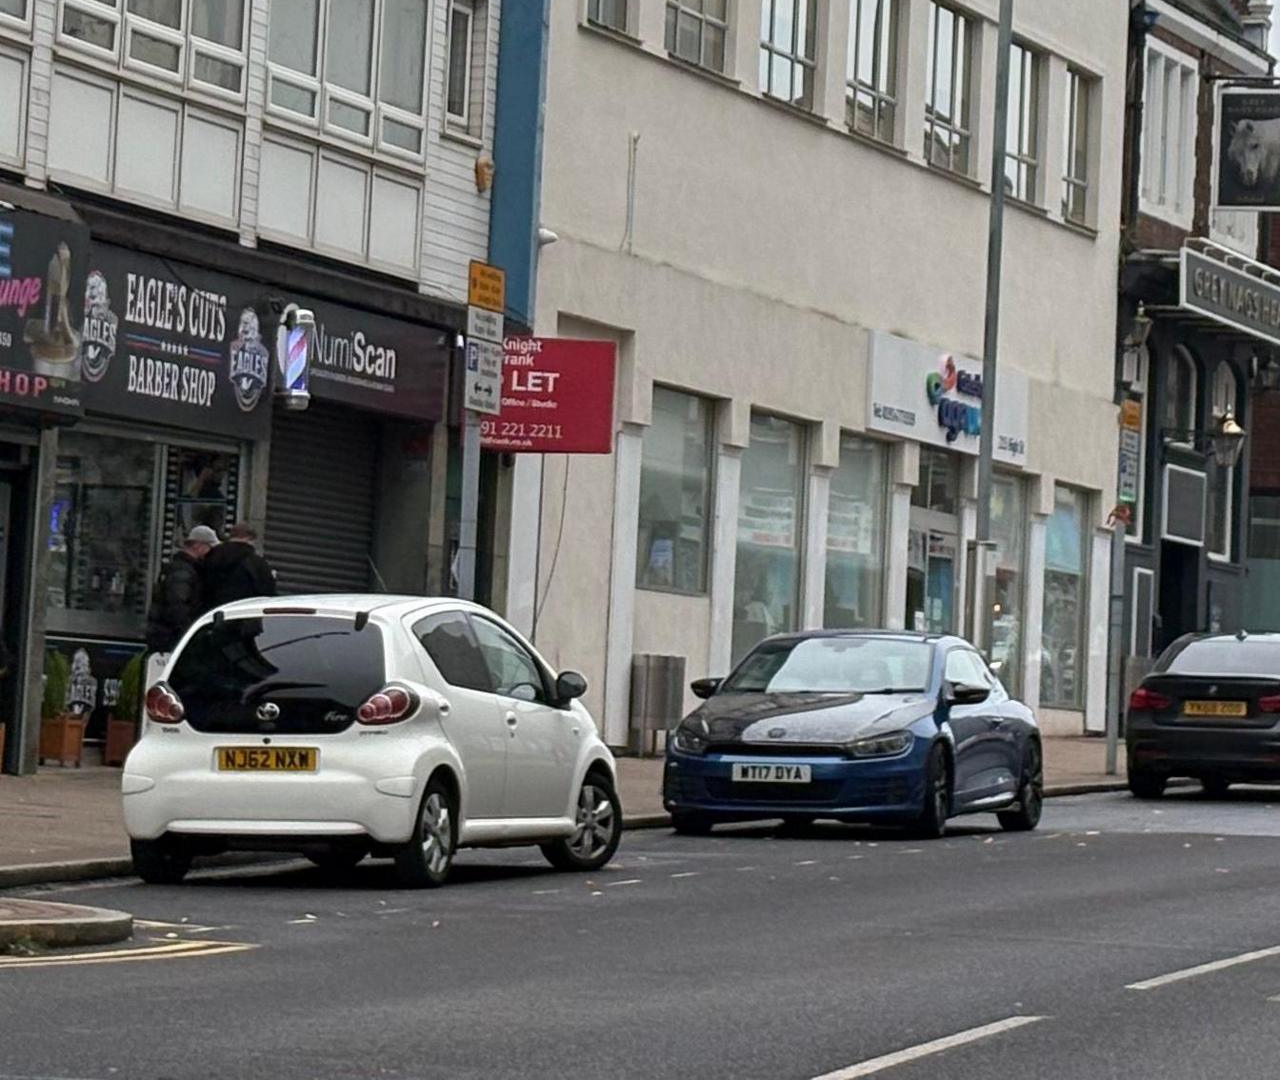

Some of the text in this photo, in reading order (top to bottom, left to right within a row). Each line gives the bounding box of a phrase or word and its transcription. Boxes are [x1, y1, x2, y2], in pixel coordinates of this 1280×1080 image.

[124, 273, 228, 343] EAGLE'S CUTS
[82, 317, 117, 348] AGLES
[311, 322, 396, 380] NumiScan
[503, 354, 535, 367] rank
[230, 350, 267, 378] EAGLES
[127, 354, 217, 408] BARBER SHOP
[512, 370, 560, 392] LET
[480, 421, 563, 439] 91 221 2211
[225, 750, 310, 768] NJ62 NXW
[775, 765, 803, 780] DYA
